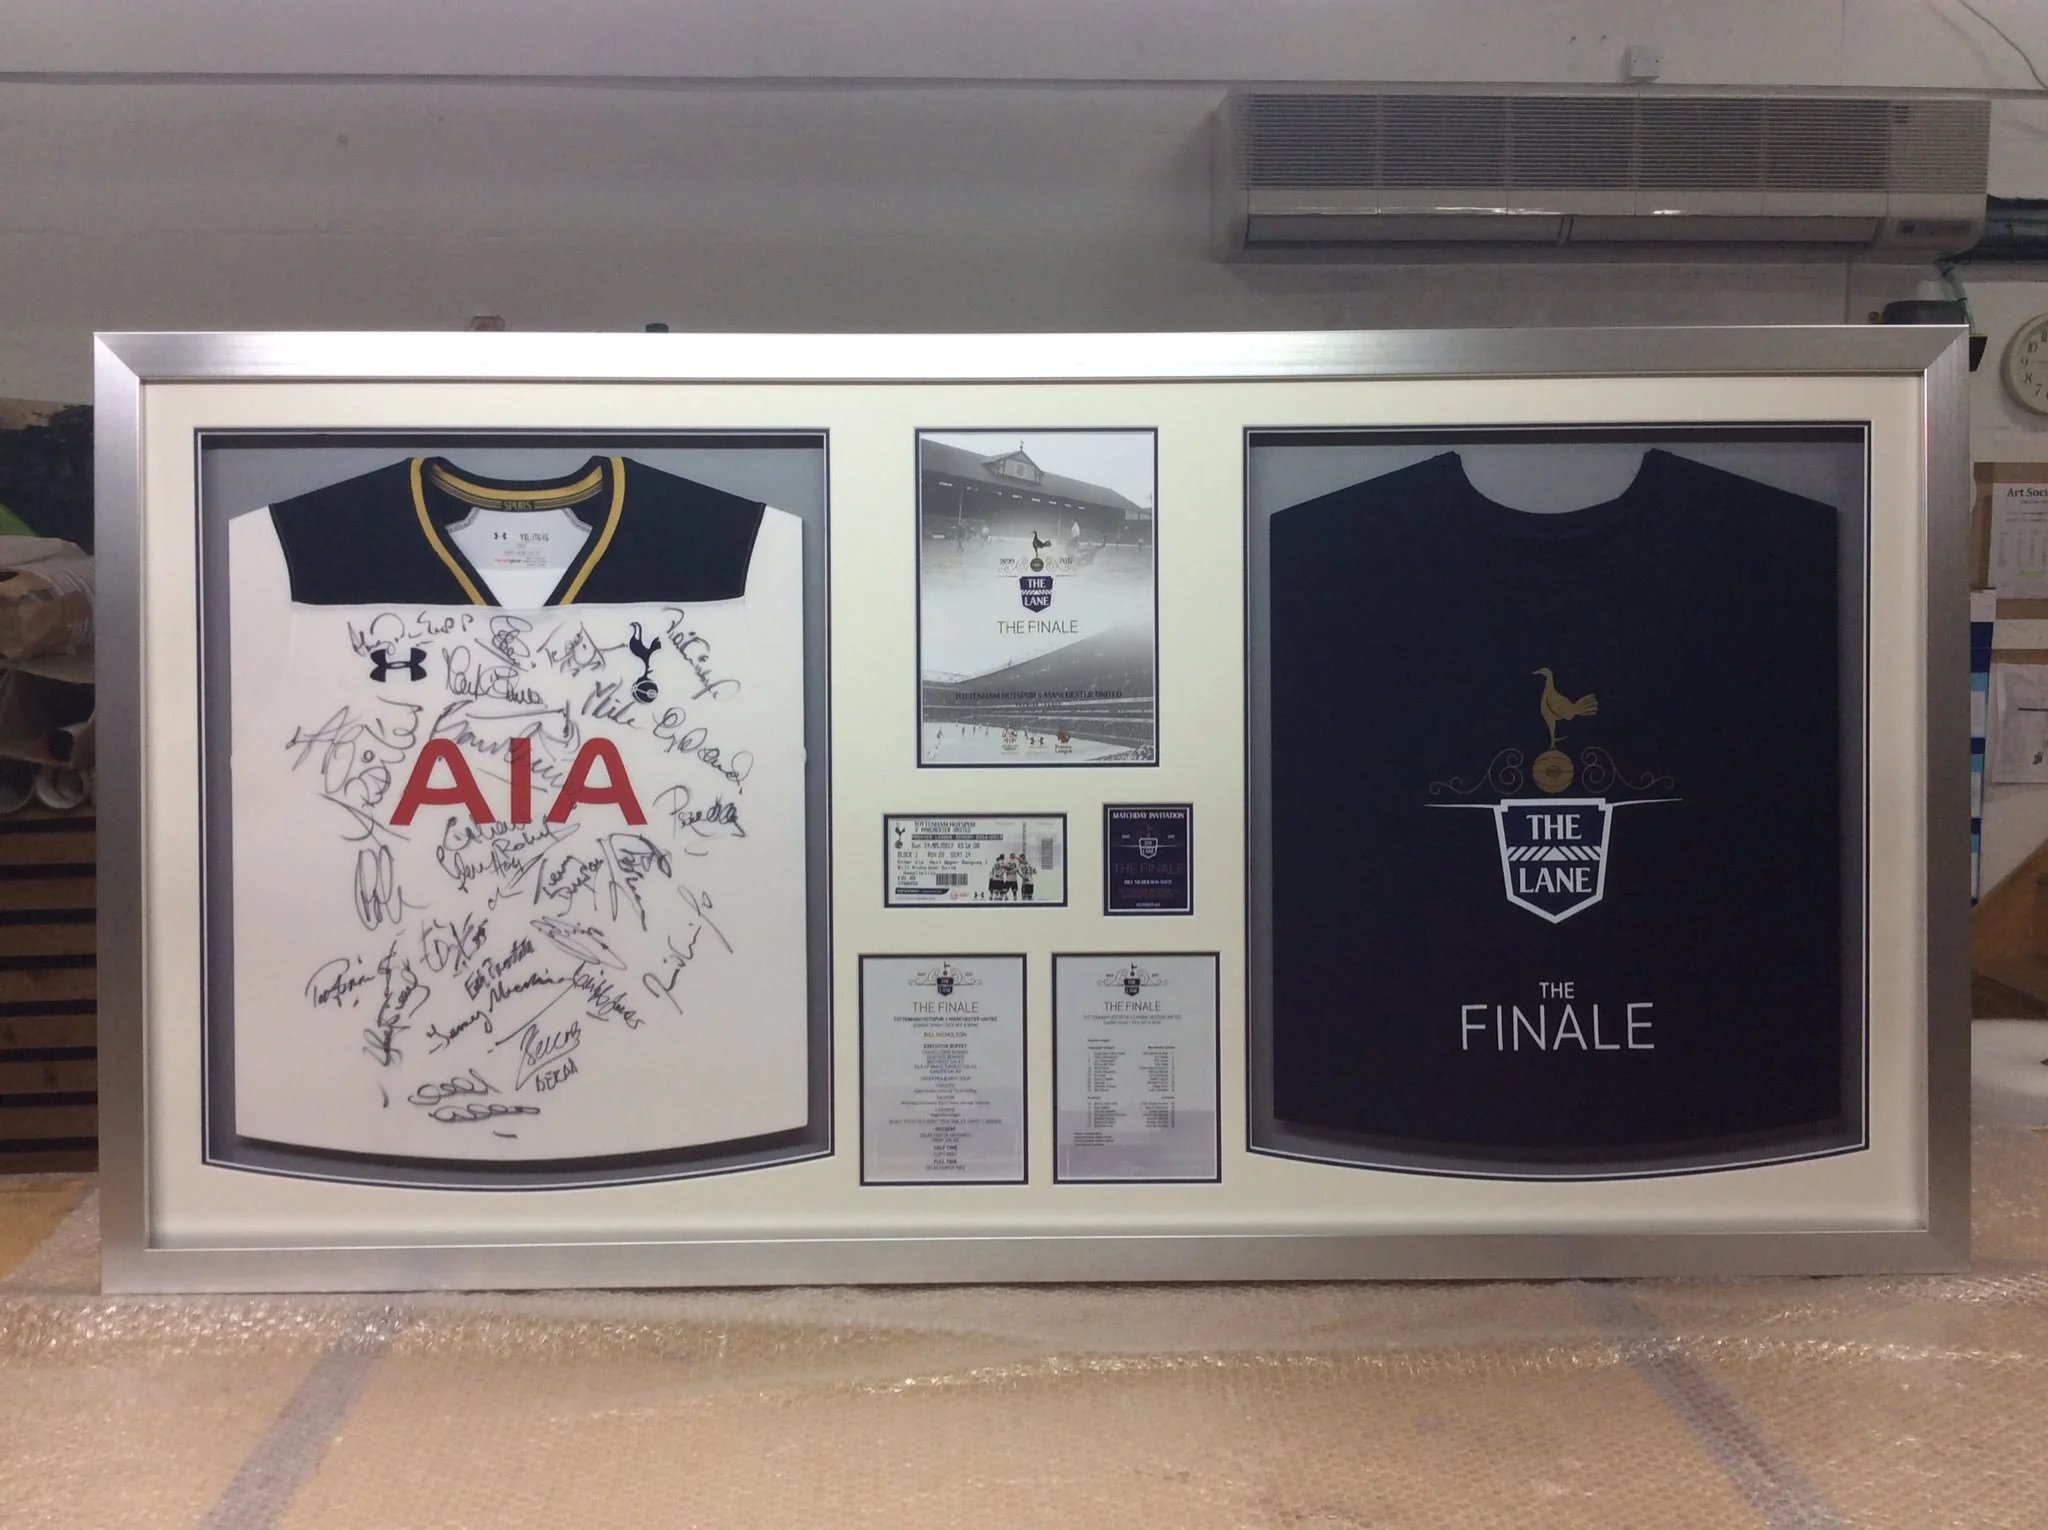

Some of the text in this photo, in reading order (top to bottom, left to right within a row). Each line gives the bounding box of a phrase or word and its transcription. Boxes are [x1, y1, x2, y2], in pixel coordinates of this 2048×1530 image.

[2035, 383, 2043, 396] 7
[2006, 487, 2025, 498] Art
[502, 500, 533, 511] SPURS
[1027, 578, 1046, 589] THE
[1024, 596, 1050, 606] LANE
[997, 619, 1079, 635] THE FINALE
[955, 691, 1001, 700] TOTTENHAM
[1043, 690, 1094, 700] MANCHESTER
[1095, 690, 1123, 699] UNITED
[389, 737, 648, 826] AIA
[1526, 814, 1582, 840] THE
[1519, 867, 1592, 893] LANE
[1539, 981, 1575, 999] THE
[913, 1001, 979, 1013] THE FINALE
[1104, 1001, 1161, 1011] THE FINALE
[1461, 1003, 1655, 1051] FINALE
